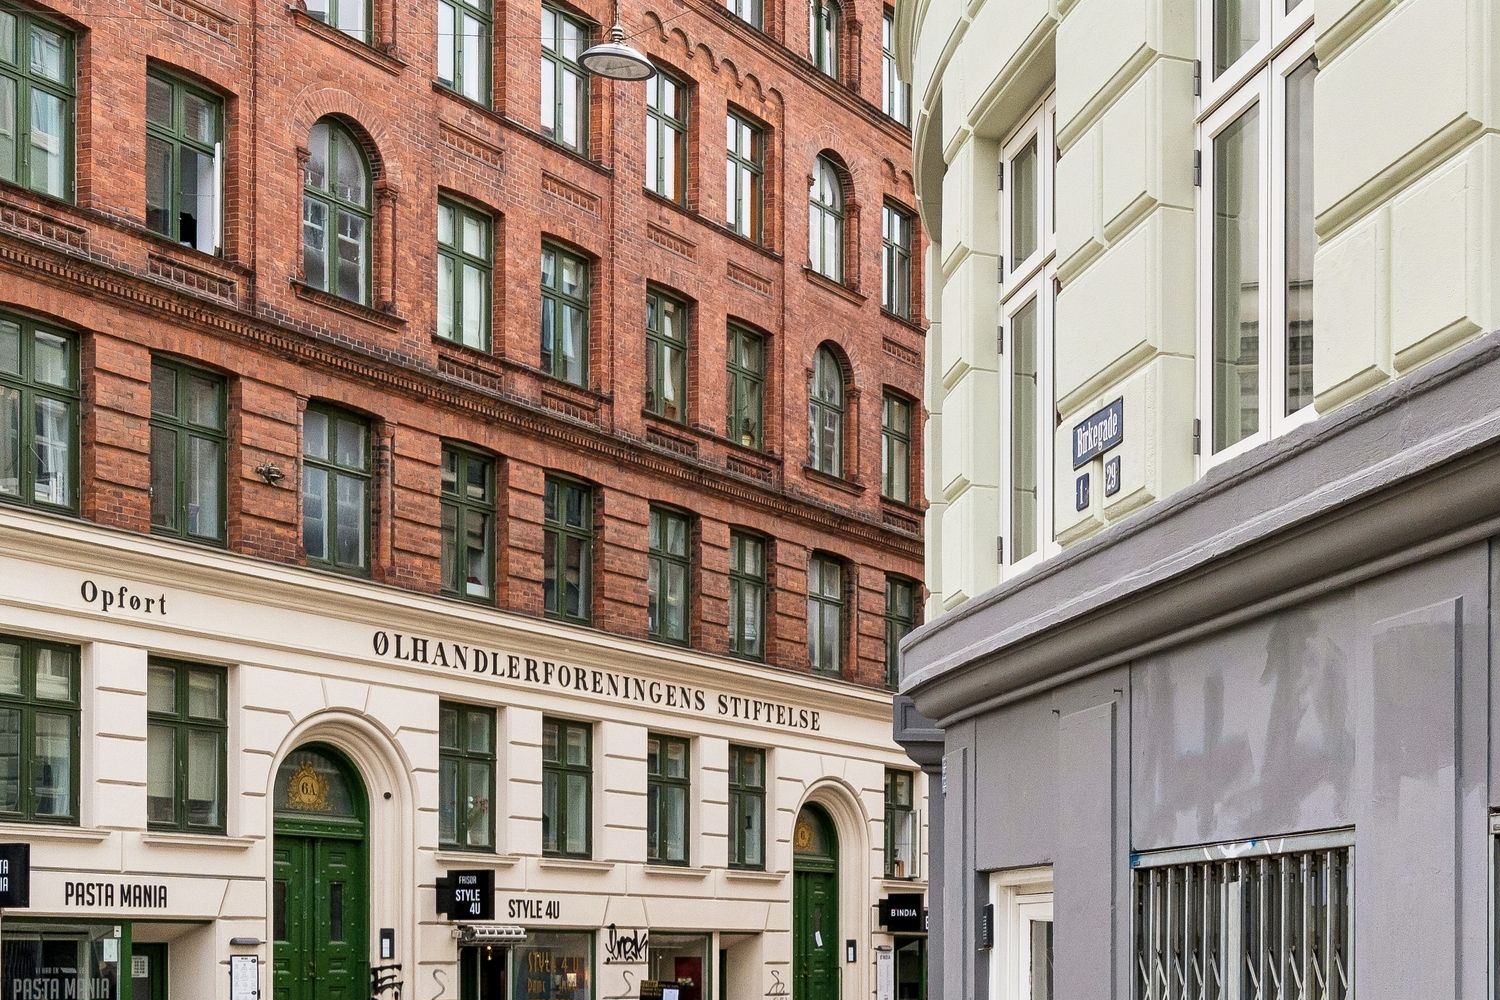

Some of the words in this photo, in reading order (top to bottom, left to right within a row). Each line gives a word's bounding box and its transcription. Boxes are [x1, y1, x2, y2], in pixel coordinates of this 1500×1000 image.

[1077, 408, 1118, 458] Birkegade
[1106, 462, 1116, 492] 29
[81, 580, 166, 615] Opført
[373, 630, 705, 711] ØLHANDLERFORENINGENS
[718, 694, 821, 731] STIFTELSE
[65, 882, 114, 906] PASTA
[120, 884, 168, 908] MANIA
[455, 889, 480, 902] STYLE
[469, 902, 480, 914] 4U
[508, 899, 543, 919] STYLE
[545, 900, 560, 919] 4U
[13, 978, 60, 1000] PASTA
[64, 978, 110, 1000] MANIA
